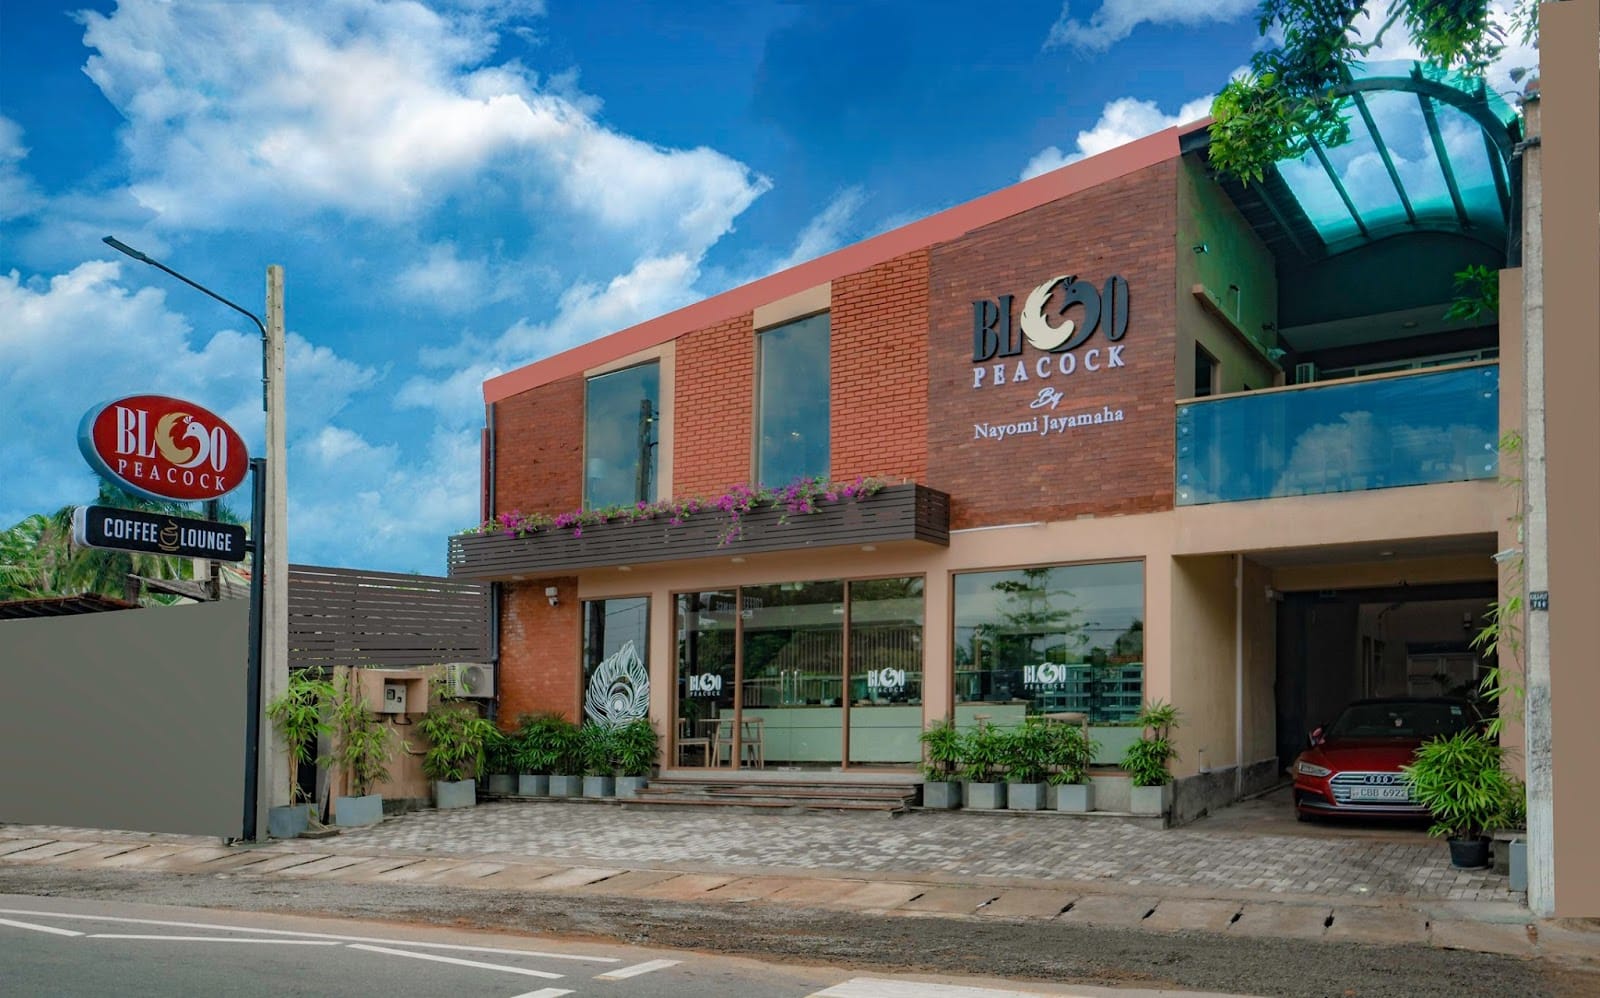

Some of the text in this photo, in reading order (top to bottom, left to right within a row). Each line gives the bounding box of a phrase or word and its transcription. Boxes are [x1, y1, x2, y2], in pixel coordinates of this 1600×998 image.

[973, 344, 1125, 388] PEACOCK
[1030, 386, 1063, 409] By
[974, 406, 1124, 440] Nayomi Jayamaha
[118, 458, 225, 491] PEACOCK
[104, 517, 232, 552] COFFEE LOUNGE
